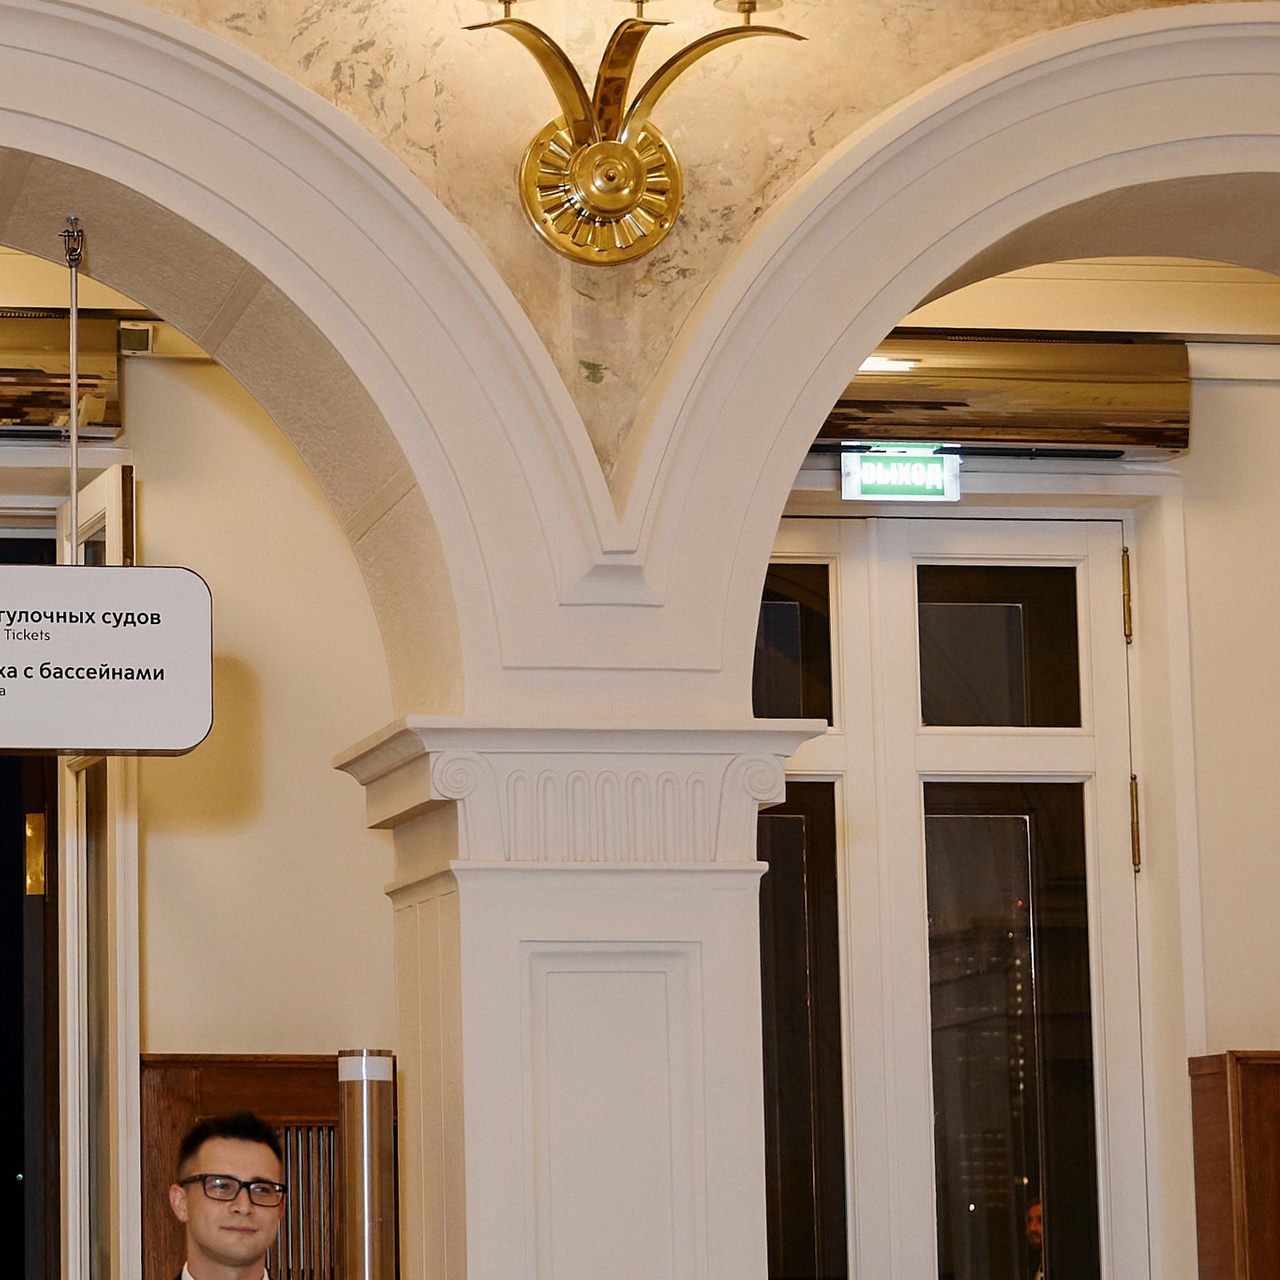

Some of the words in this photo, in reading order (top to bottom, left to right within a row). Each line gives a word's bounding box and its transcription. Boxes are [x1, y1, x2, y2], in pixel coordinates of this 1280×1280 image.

[862, 462, 943, 490] ВЫХОД
[102, 612, 161, 628] судов
[4, 629, 50, 640] Tickets
[24, 667, 33, 678] с
[40, 662, 164, 680] бассейнами
